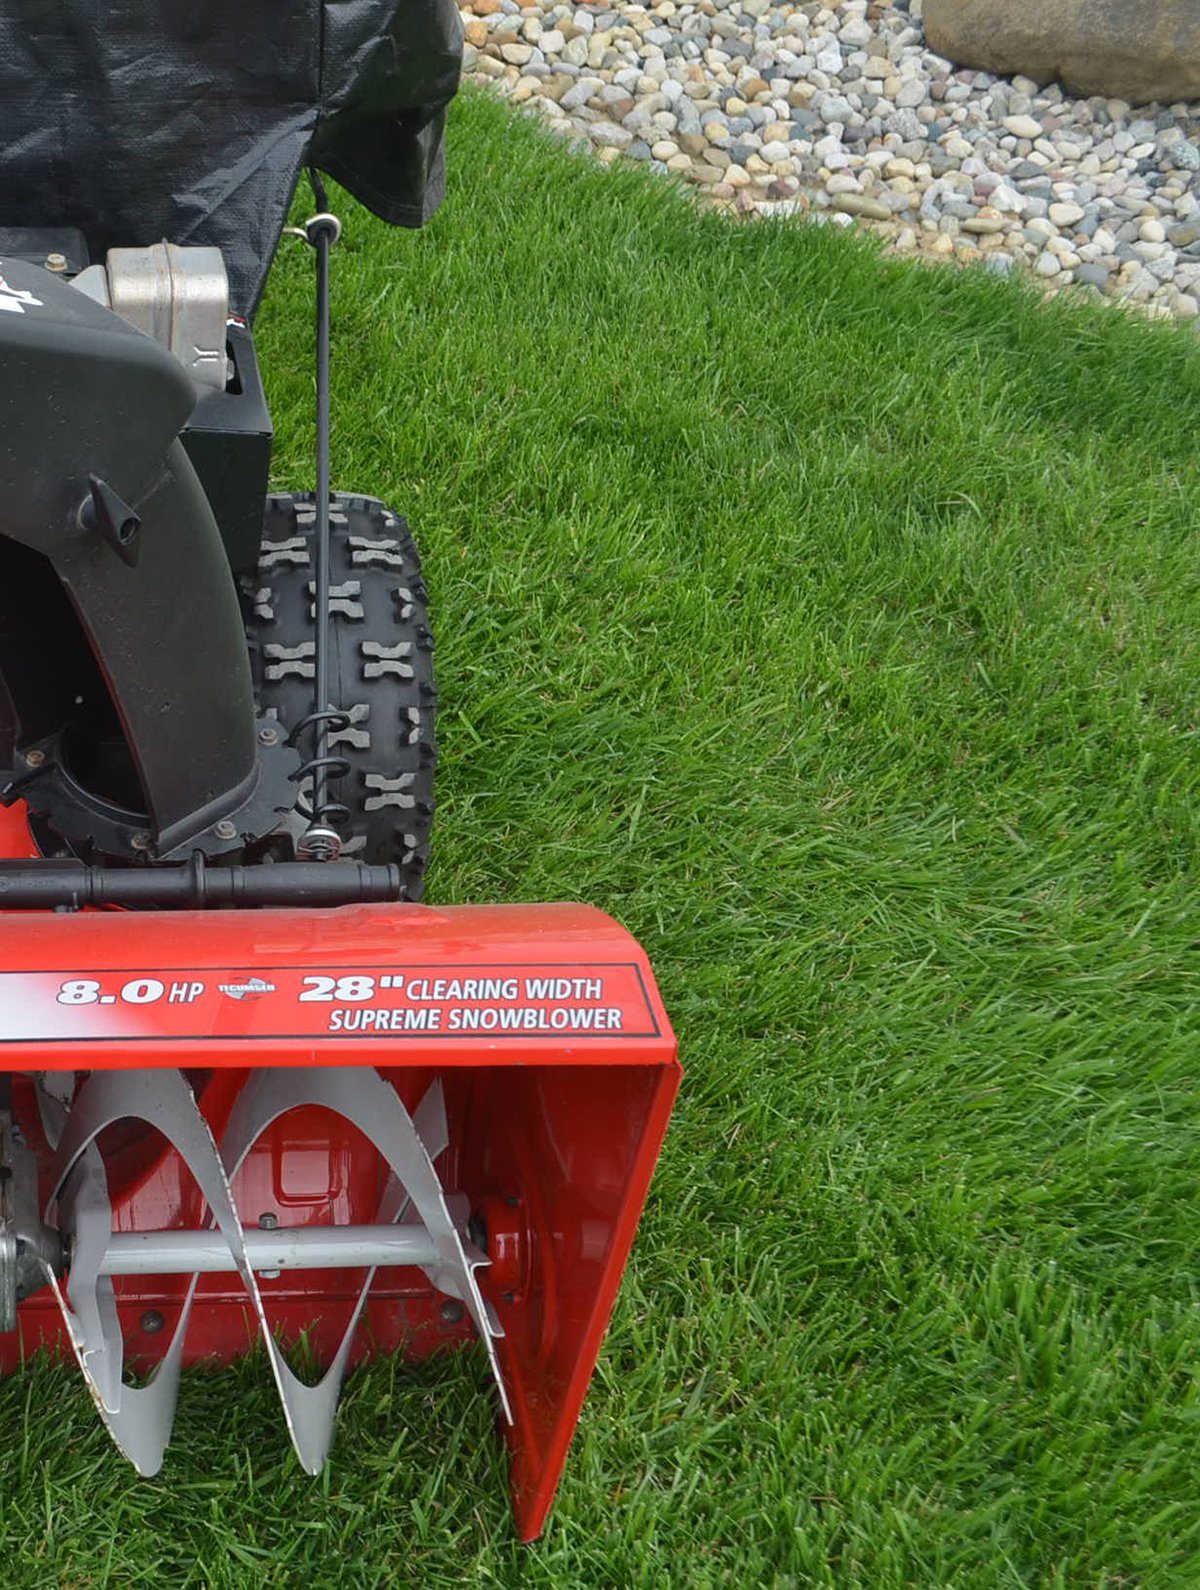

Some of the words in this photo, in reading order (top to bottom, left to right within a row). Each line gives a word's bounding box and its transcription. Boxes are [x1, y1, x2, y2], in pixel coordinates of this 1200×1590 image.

[56, 978, 164, 1004] 8.0
[167, 981, 204, 1004] HP
[298, 975, 404, 1002] 28"
[405, 978, 518, 1001] CLEARING
[525, 977, 603, 1000] WIDTH
[328, 1008, 441, 1031] SUPREME
[448, 1007, 623, 1030] SNOWBLOWER
